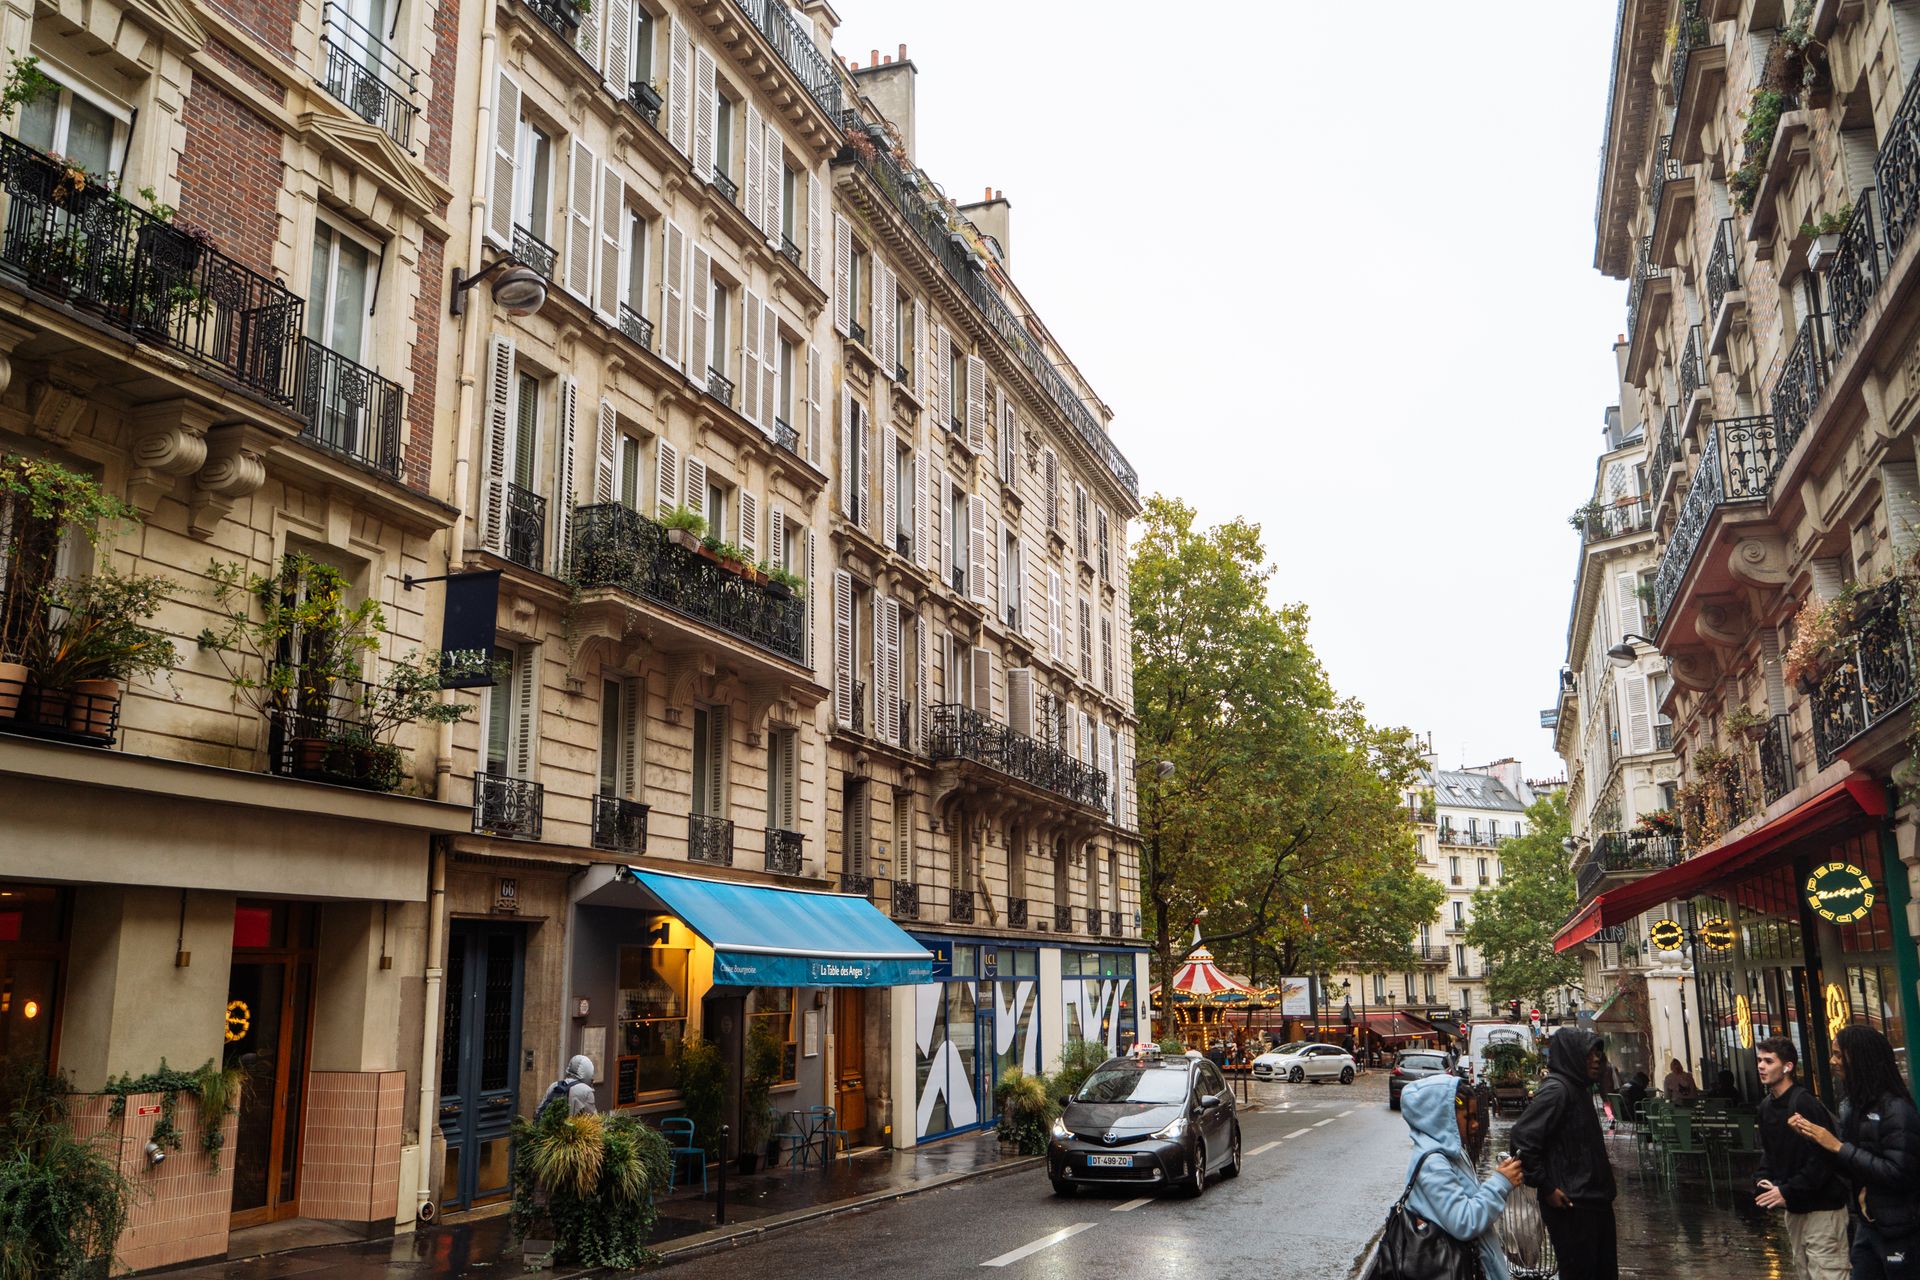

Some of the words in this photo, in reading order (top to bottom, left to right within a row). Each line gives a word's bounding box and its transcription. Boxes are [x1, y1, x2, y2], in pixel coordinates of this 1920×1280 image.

[502, 880, 514, 897] 66
[985, 953, 997, 965] LCL
[820, 964, 827, 976] La
[827, 964, 840, 976] Table
[840, 965, 849, 976] des
[848, 965, 863, 979] Anges
